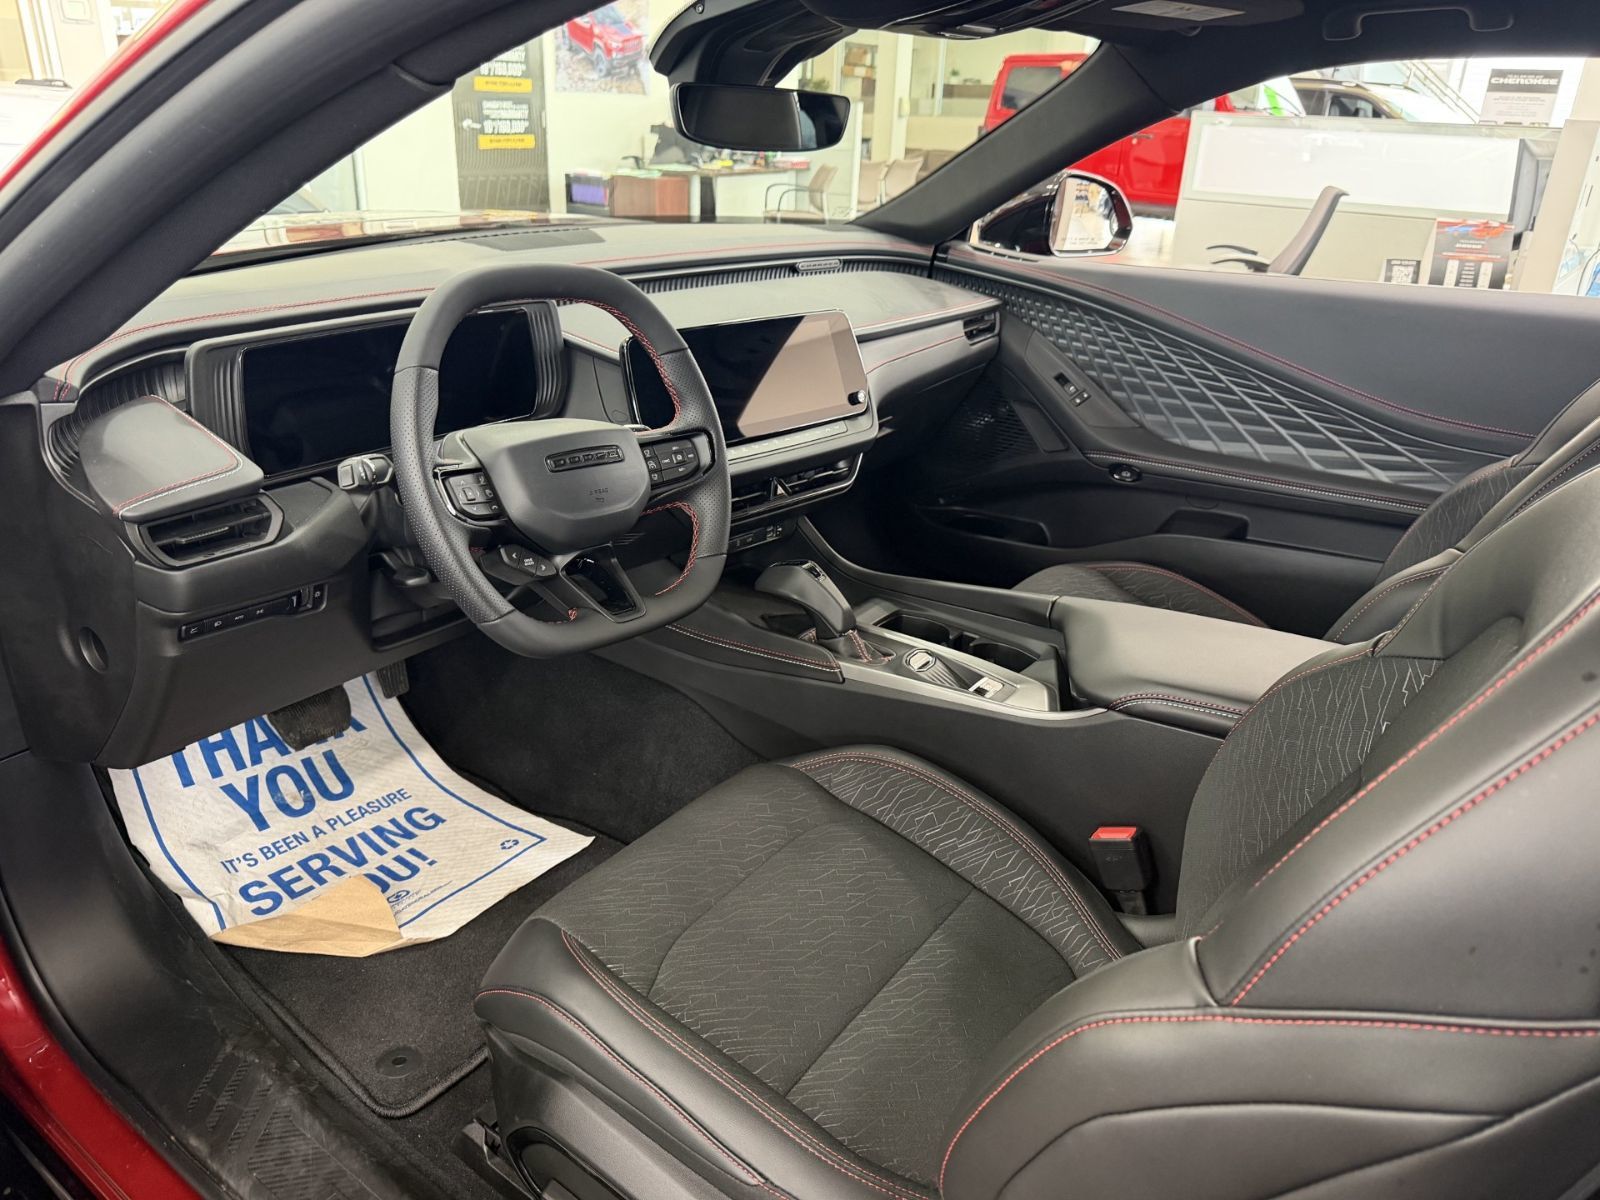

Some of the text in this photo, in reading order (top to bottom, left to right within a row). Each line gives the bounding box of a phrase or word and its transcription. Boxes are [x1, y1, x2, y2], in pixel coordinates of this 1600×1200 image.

[220, 750, 354, 832] YOU
[258, 831, 310, 860] BEEN
[311, 825, 327, 839] A
[325, 788, 412, 831] PLEASURE
[238, 806, 447, 916] SERVING
